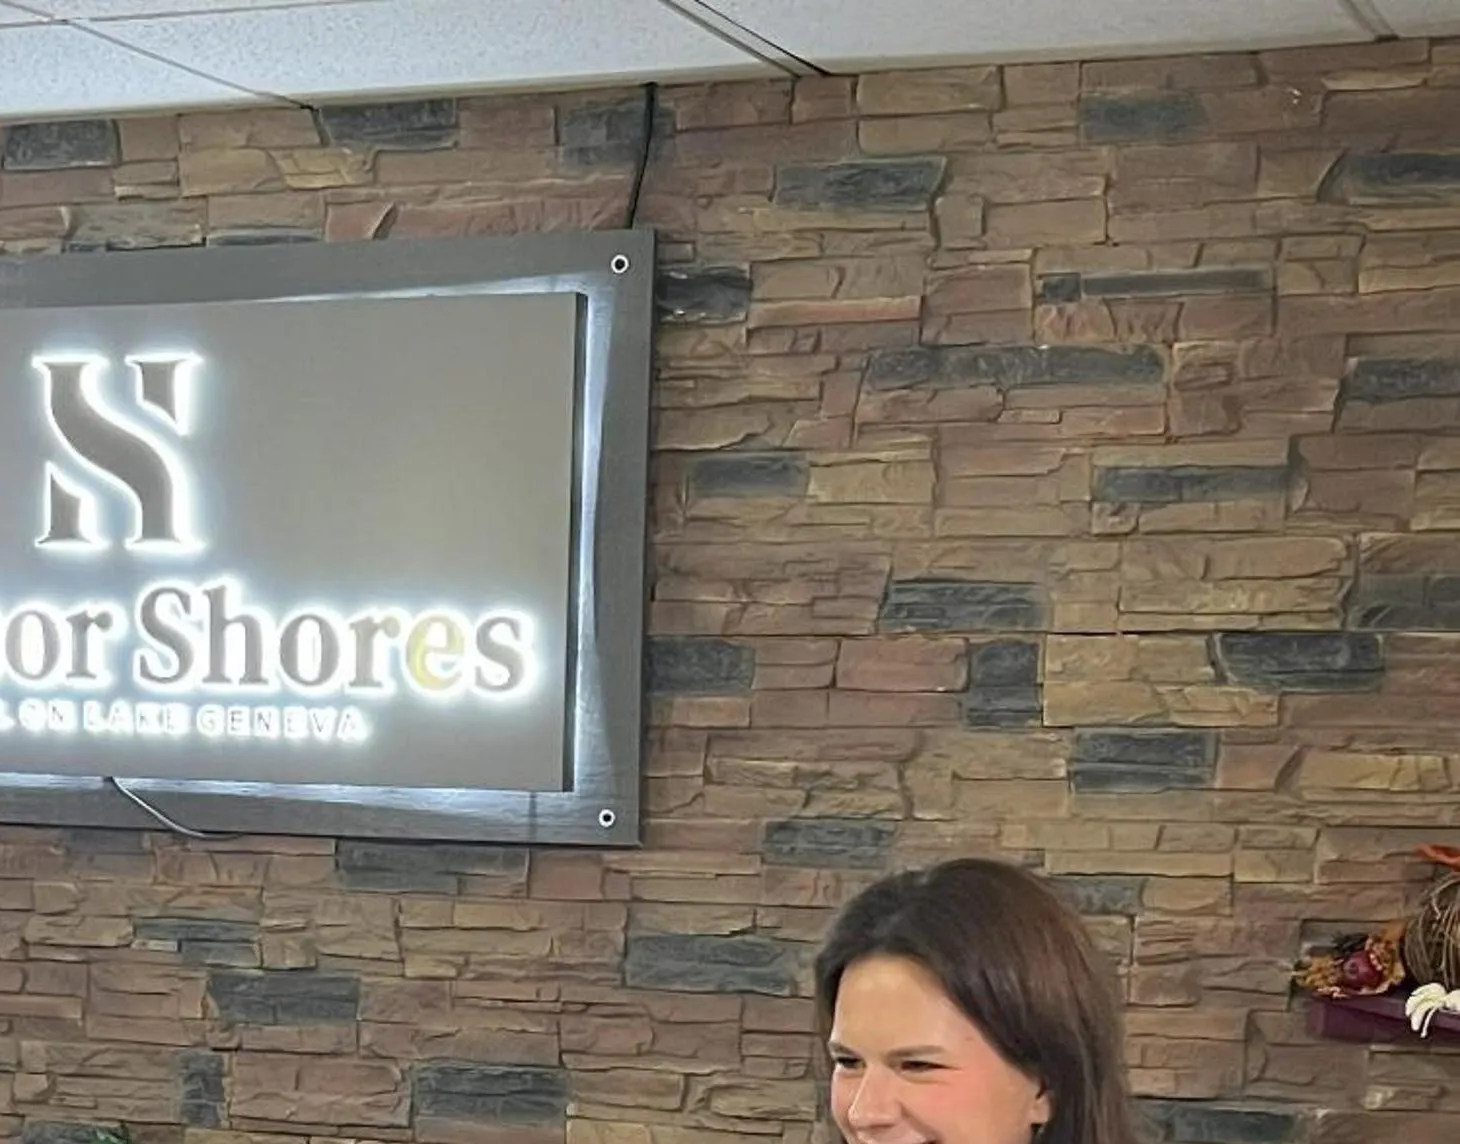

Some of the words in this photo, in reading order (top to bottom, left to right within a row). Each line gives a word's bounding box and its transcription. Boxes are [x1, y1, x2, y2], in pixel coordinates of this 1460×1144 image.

[137, 583, 528, 693] Shores
[19, 699, 74, 731] ON
[84, 701, 189, 735] LAKE
[197, 704, 369, 742] GENEVA
